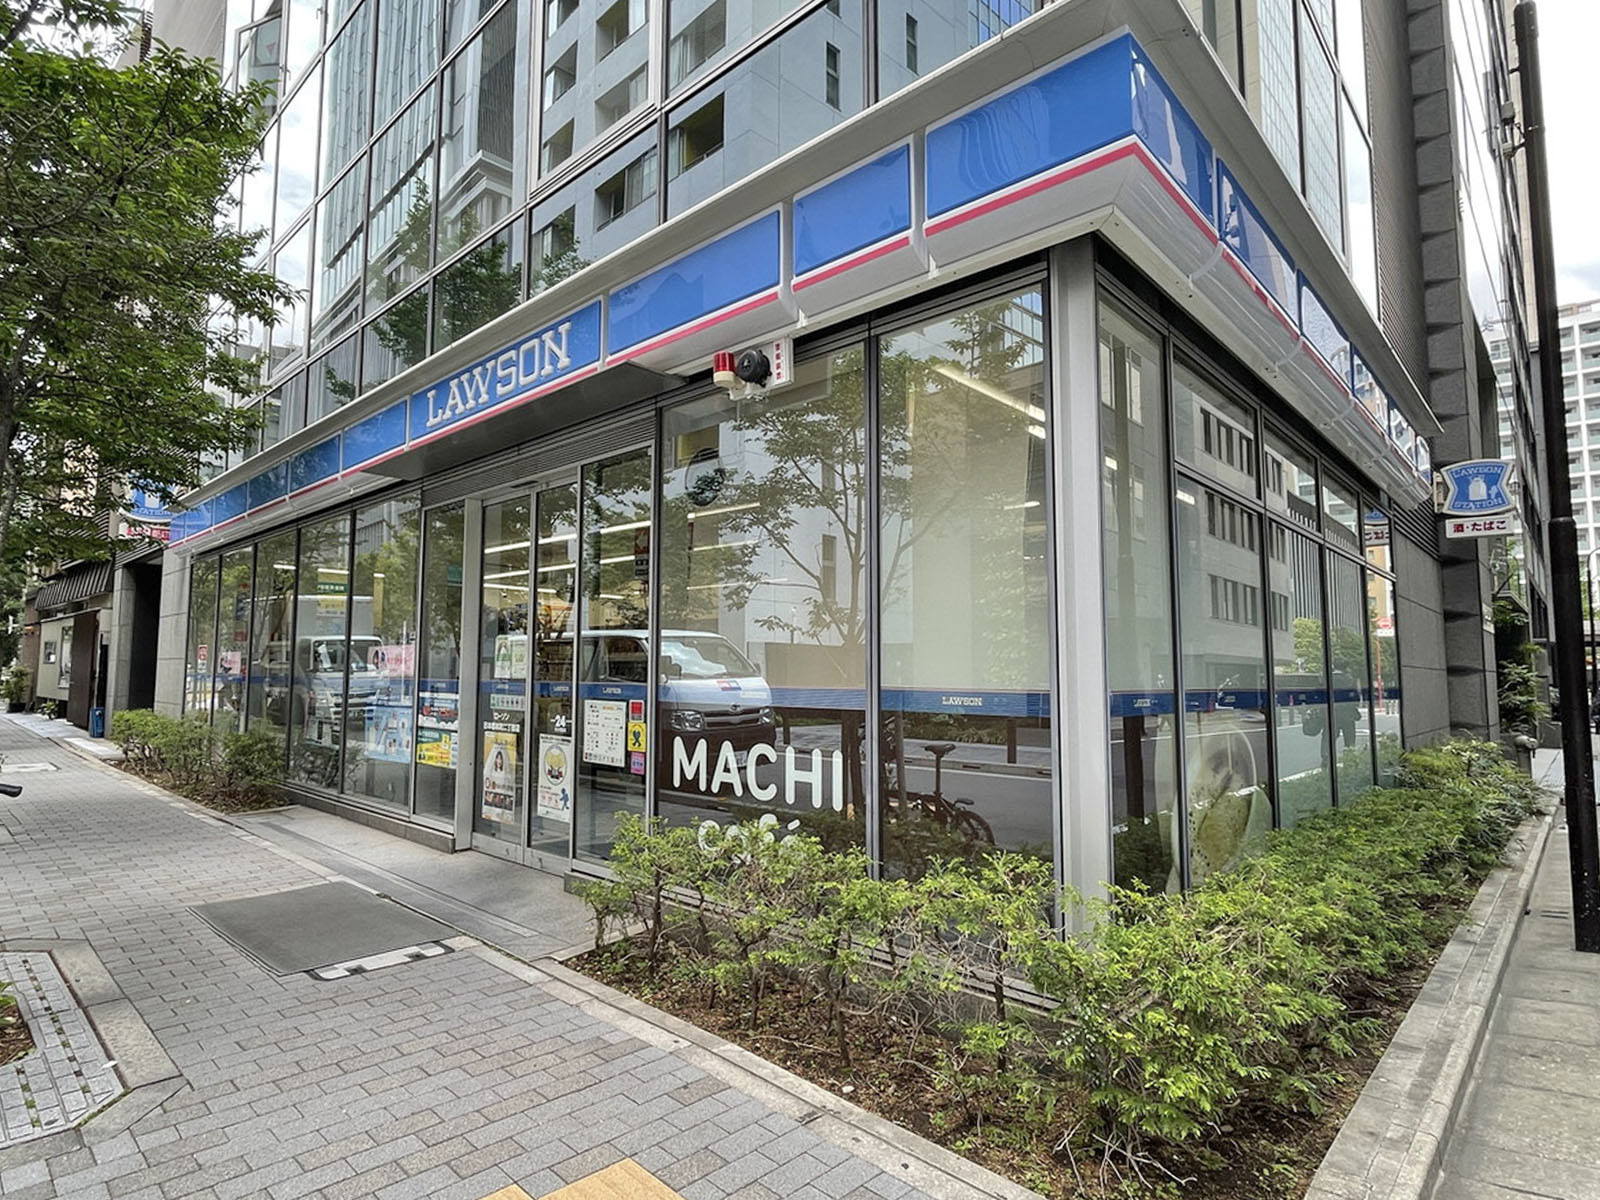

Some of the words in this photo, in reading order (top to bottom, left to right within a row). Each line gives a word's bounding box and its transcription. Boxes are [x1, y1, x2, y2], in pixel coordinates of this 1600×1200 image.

[426, 322, 571, 428] LAWSON
[1452, 466, 1502, 478] LAWSON
[1454, 497, 1502, 510] STATION
[1453, 520, 1507, 533] 酒・たばこ
[942, 696, 983, 706] LAWSON
[673, 736, 843, 811] MACHI
